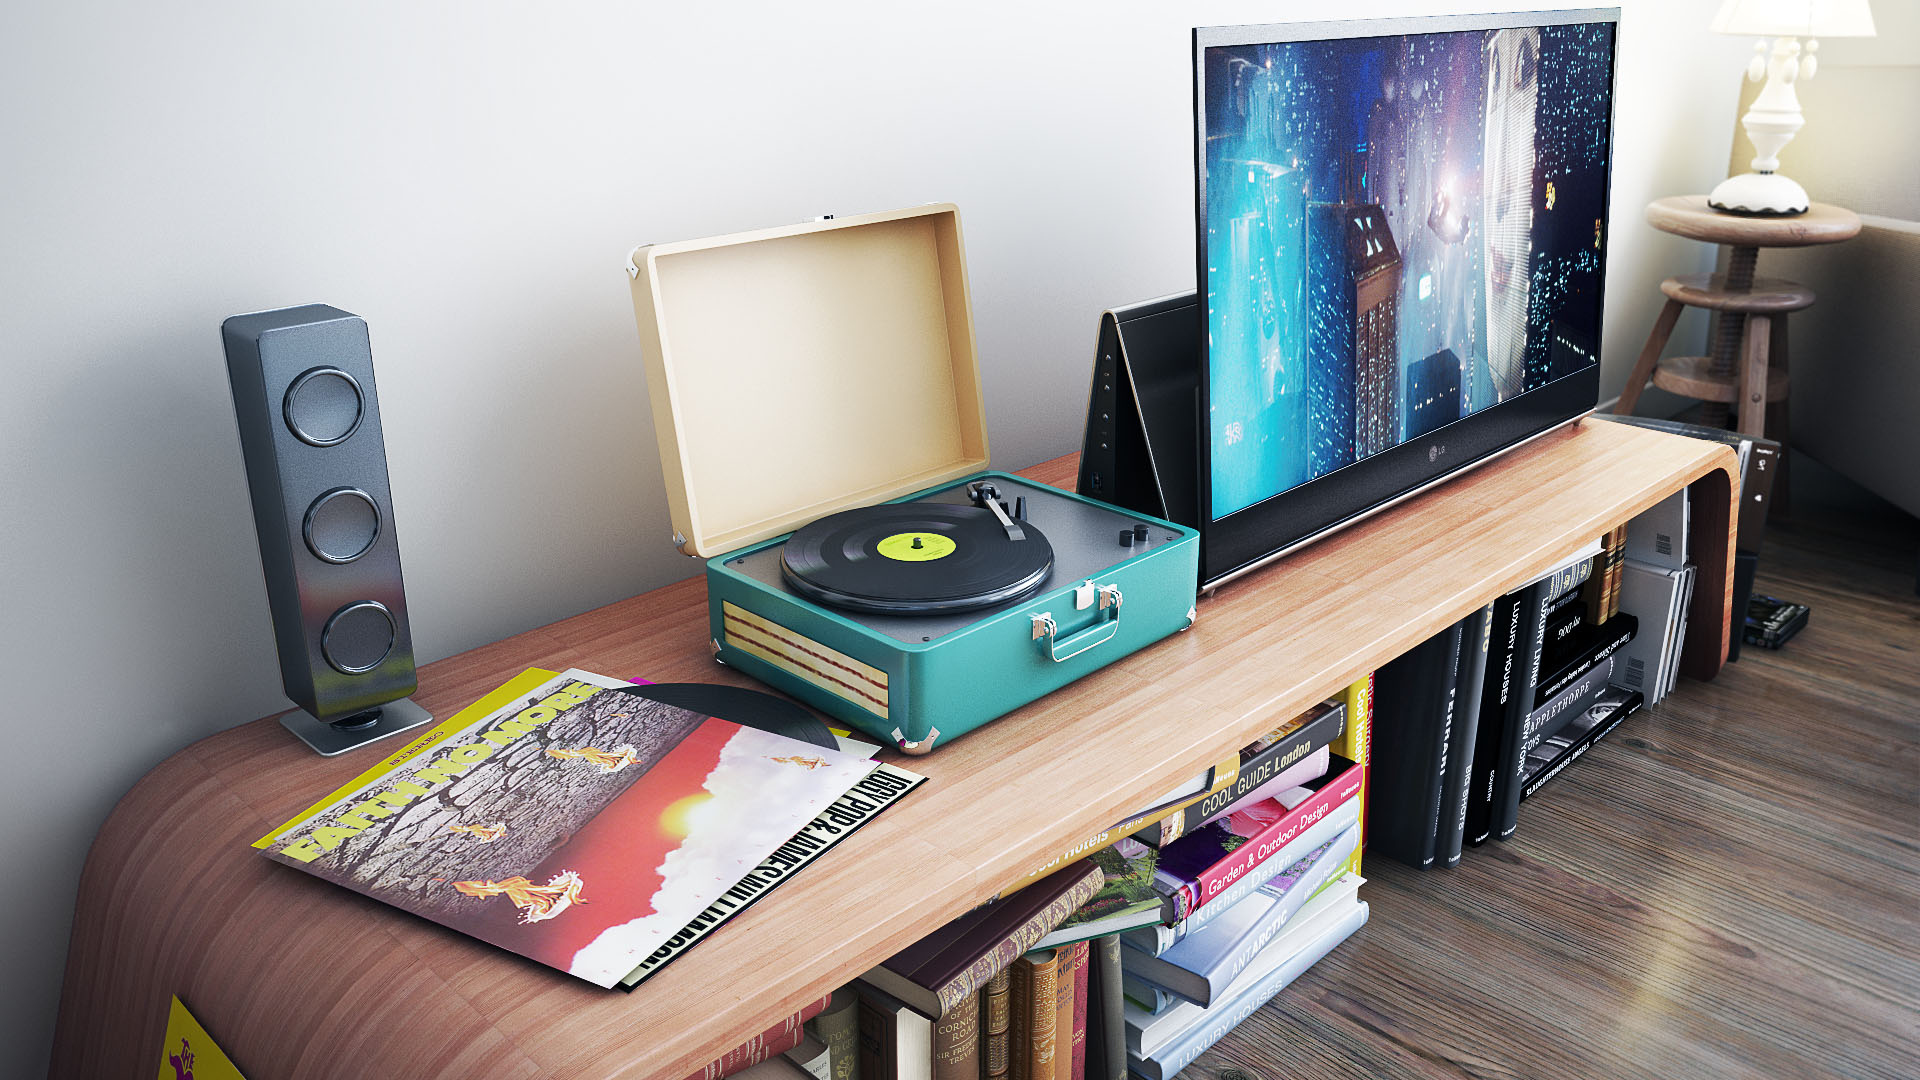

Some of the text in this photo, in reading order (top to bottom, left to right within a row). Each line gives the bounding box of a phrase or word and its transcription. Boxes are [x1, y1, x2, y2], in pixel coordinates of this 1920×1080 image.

[1508, 601, 1520, 649] LUXURY
[1501, 653, 1513, 704] HOUSES
[1516, 597, 1549, 776] LUXURY LIVING NEW YORK
[1354, 687, 1367, 764] Cool Hotels
[1530, 680, 1591, 732] APPLETHORPE
[388, 730, 444, 765] STEREO
[1440, 688, 1456, 776] FERRARI
[1571, 741, 1590, 765] ANGELS
[279, 681, 602, 863] FAITH NO MORE
[849, 769, 913, 804] IGGY
[1201, 792, 1233, 817] COOL
[1238, 765, 1271, 794] GUIDE
[1274, 740, 1311, 771] London
[1463, 765, 1473, 786] BIG
[808, 814, 842, 834] &
[825, 794, 877, 828] POP
[1458, 790, 1470, 830] SHOTS
[1208, 801, 1330, 897] Garden & Outdoor Design
[1197, 853, 1292, 925] Kitchen Design
[1231, 909, 1288, 979] ANTARCTIC
[938, 1006, 979, 1035] CORNICH
[951, 1011, 962, 1020] OF
[952, 1020, 976, 1041] ROAD
[1178, 980, 1283, 1069] LUXURY HOUSES
[936, 1051, 950, 1060] SIR
